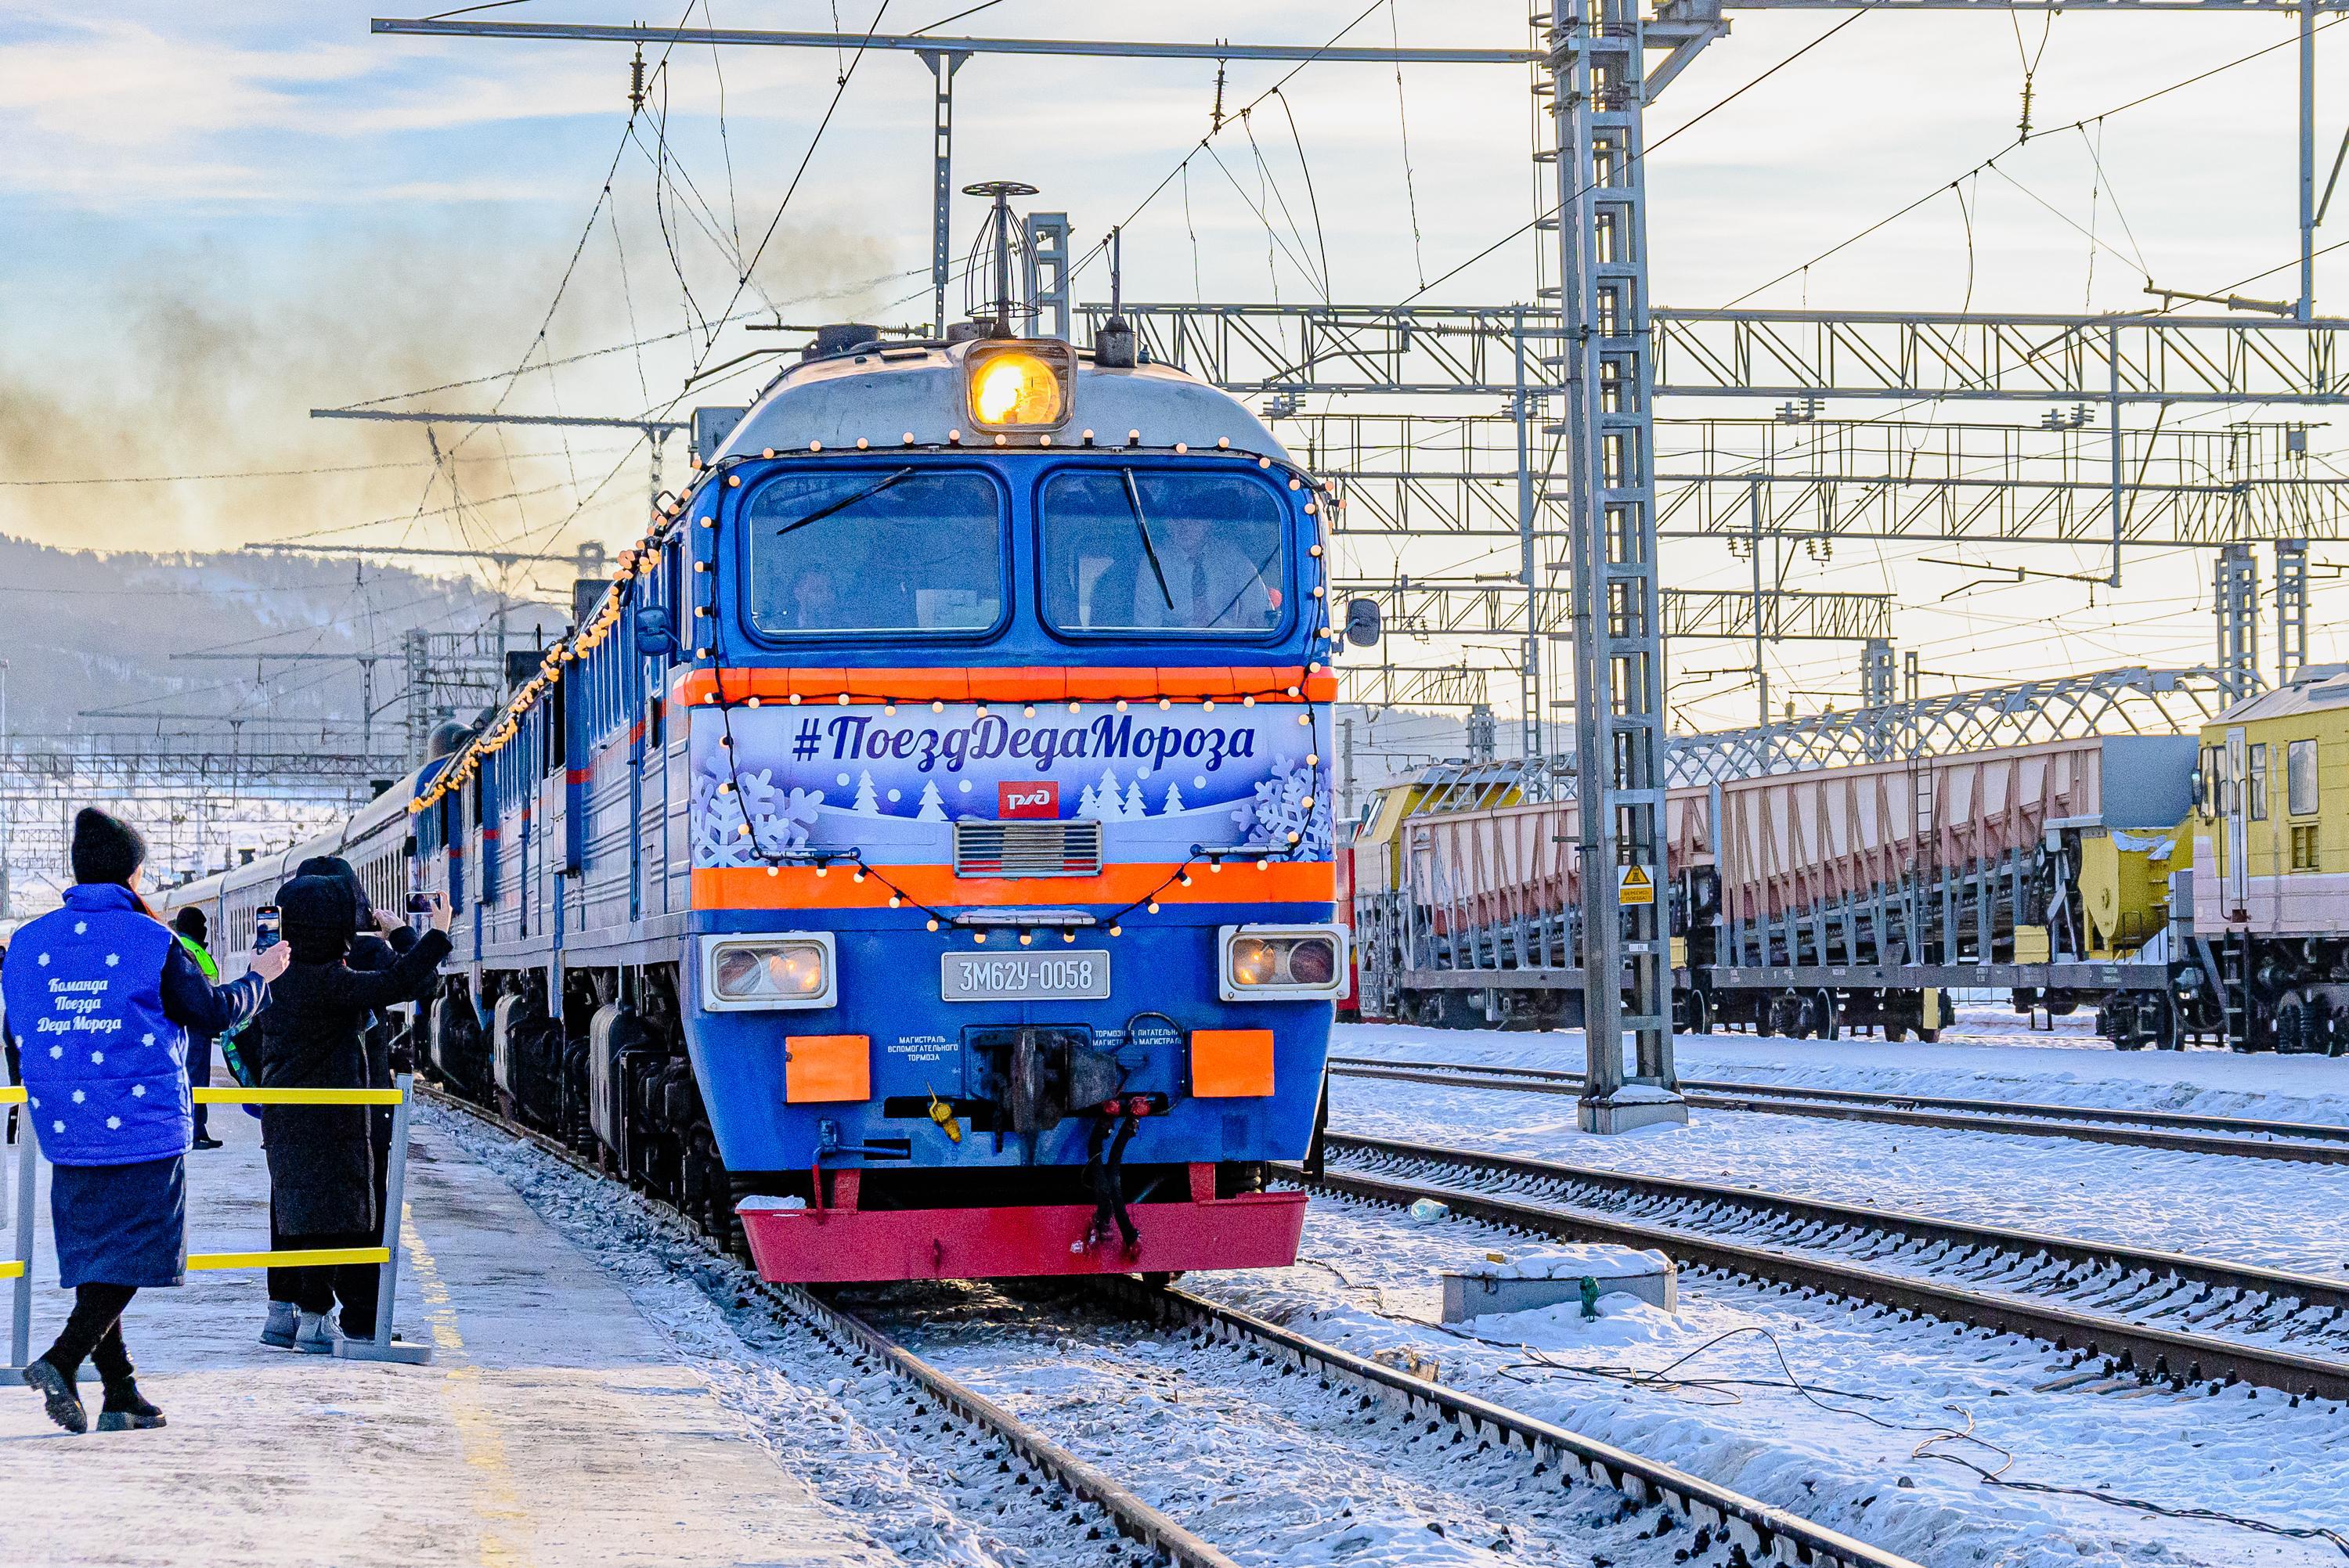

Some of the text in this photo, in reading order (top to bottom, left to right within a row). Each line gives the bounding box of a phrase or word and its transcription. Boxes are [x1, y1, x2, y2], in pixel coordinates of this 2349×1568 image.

[792, 713, 1255, 772] #ПоездДедаМороза
[48, 978, 108, 995] Команда
[54, 996, 101, 1013] Поезда
[37, 1015, 122, 1035] Деда Мороза
[887, 1044, 958, 1053] ВСПОМОГАТЕЛЬНОГО
